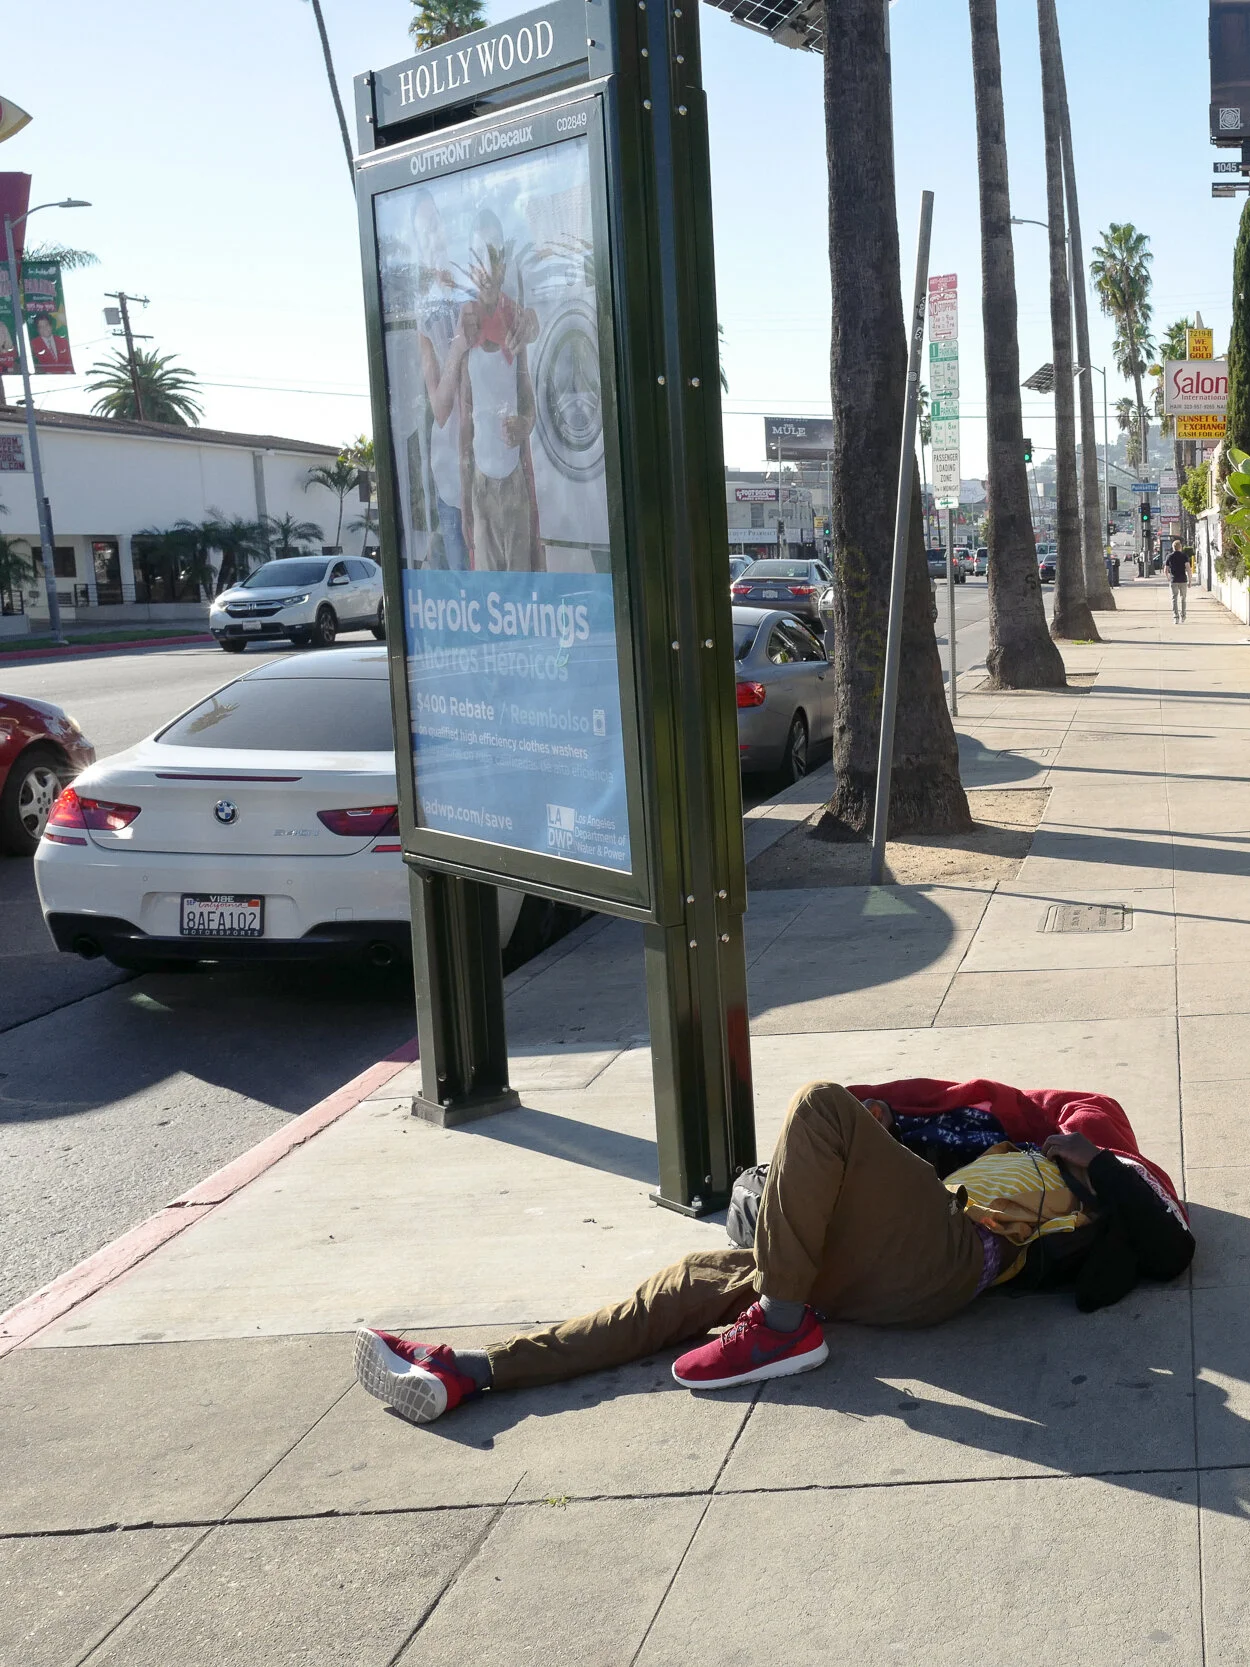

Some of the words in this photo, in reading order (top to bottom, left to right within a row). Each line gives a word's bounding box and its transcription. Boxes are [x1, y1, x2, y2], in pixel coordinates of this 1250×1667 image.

[398, 20, 554, 106] HOLLYWOOD
[556, 112, 587, 132] CD2849
[410, 139, 472, 175] OUTFRONT
[479, 126, 533, 155] JCDecaux
[1216, 162, 1237, 172] 1045
[1172, 368, 1228, 400] Salon
[772, 426, 806, 435] MULE
[934, 453, 959, 462] PASSENGER
[936, 464, 956, 473] LOADING
[940, 474, 952, 483] ZONE
[408, 589, 482, 634] Heroic
[487, 591, 590, 649] Savings
[414, 638, 479, 673] Ahorros
[483, 644, 568, 682] Heroicos
[416, 692, 447, 715] $400
[450, 696, 494, 720] Rebate
[511, 704, 590, 733] Reembolso
[429, 726, 458, 741] qualified
[459, 729, 478, 745] high
[479, 733, 517, 752] efficiency
[519, 740, 550, 755] clothes
[552, 744, 589, 760] washers
[423, 796, 513, 831] ladwp.com/save
[547, 805, 562, 828] LA
[575, 811, 587, 824] Los
[588, 814, 616, 830] Angeles
[548, 828, 574, 851] DWP
[574, 827, 617, 846] Department
[619, 834, 626, 845] of
[575, 843, 596, 857] Water
[596, 847, 603, 856] &
[604, 849, 626, 861] Power
[199, 902, 243, 910] California
[187, 911, 257, 930] 8AFA102
